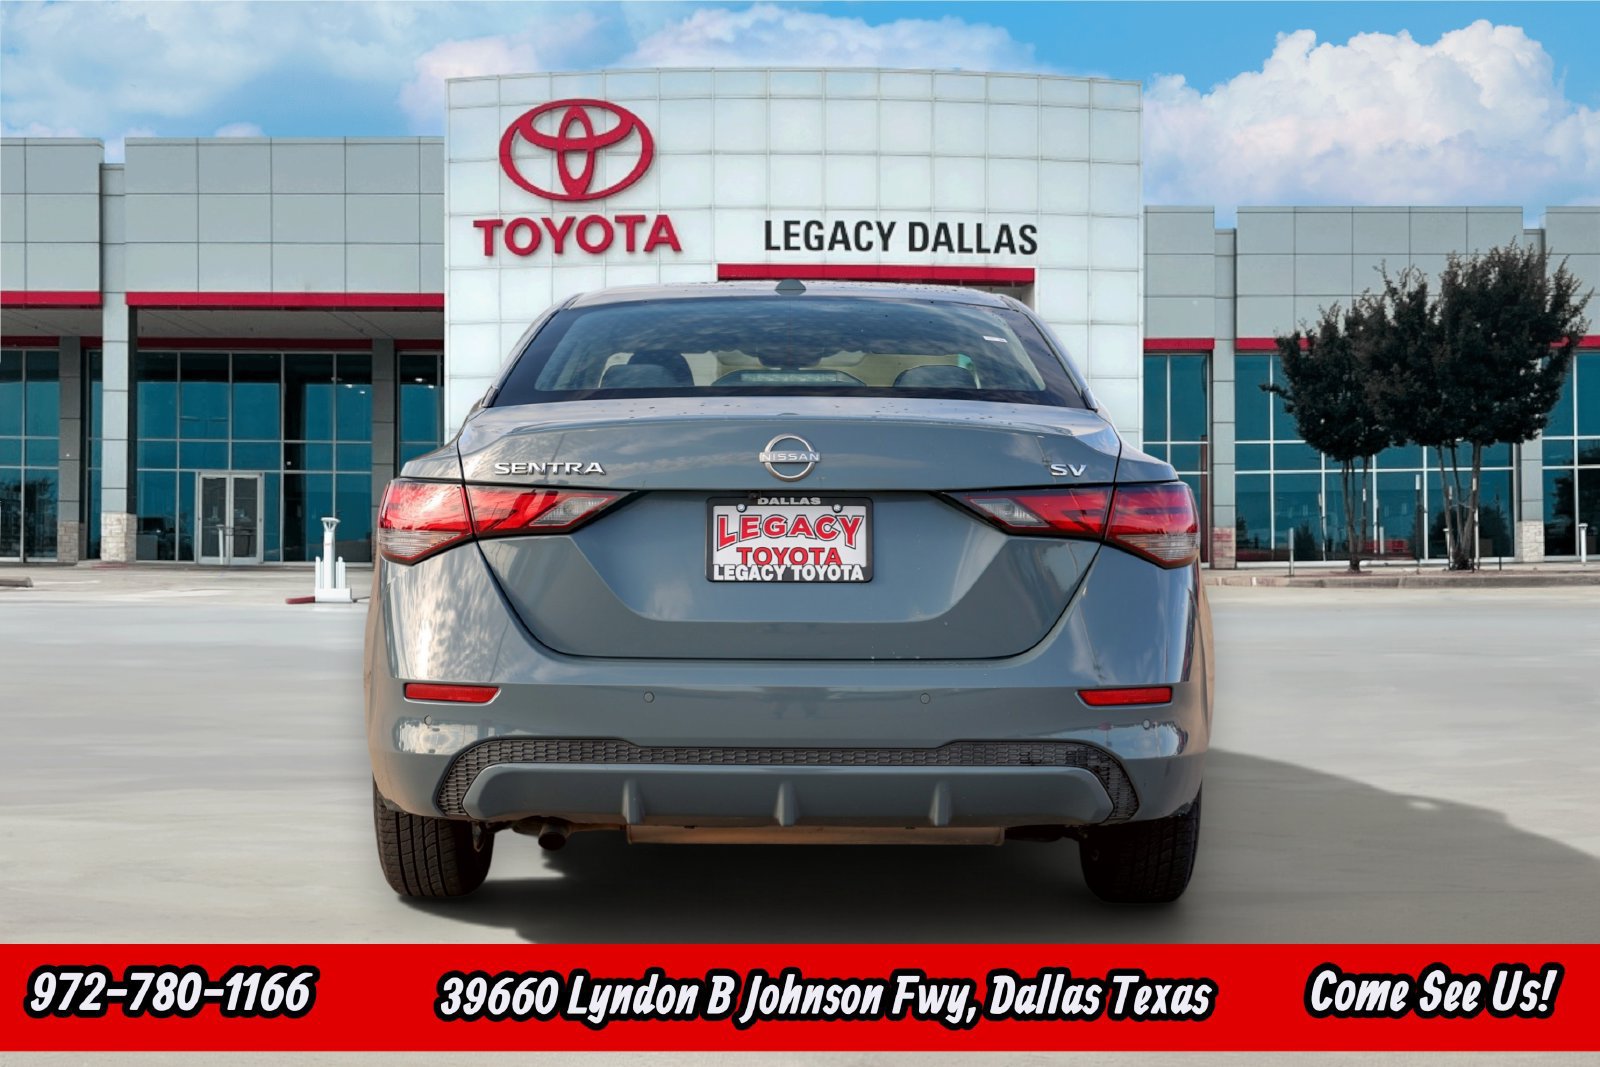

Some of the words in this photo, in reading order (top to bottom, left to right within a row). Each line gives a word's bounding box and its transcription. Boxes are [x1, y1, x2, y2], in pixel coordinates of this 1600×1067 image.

[473, 214, 681, 256] TOYOTA
[765, 220, 897, 252] LEGACY
[908, 221, 1038, 256] DALLAS
[760, 452, 820, 462] NISSAN
[494, 461, 607, 476] SENTRA
[1050, 464, 1087, 477] SV
[757, 496, 822, 505] DALLAS
[717, 514, 864, 550] LEGACY
[736, 547, 843, 565] TOYOTA
[713, 564, 787, 581] LEGACY
[791, 564, 865, 581] TOYOTA
